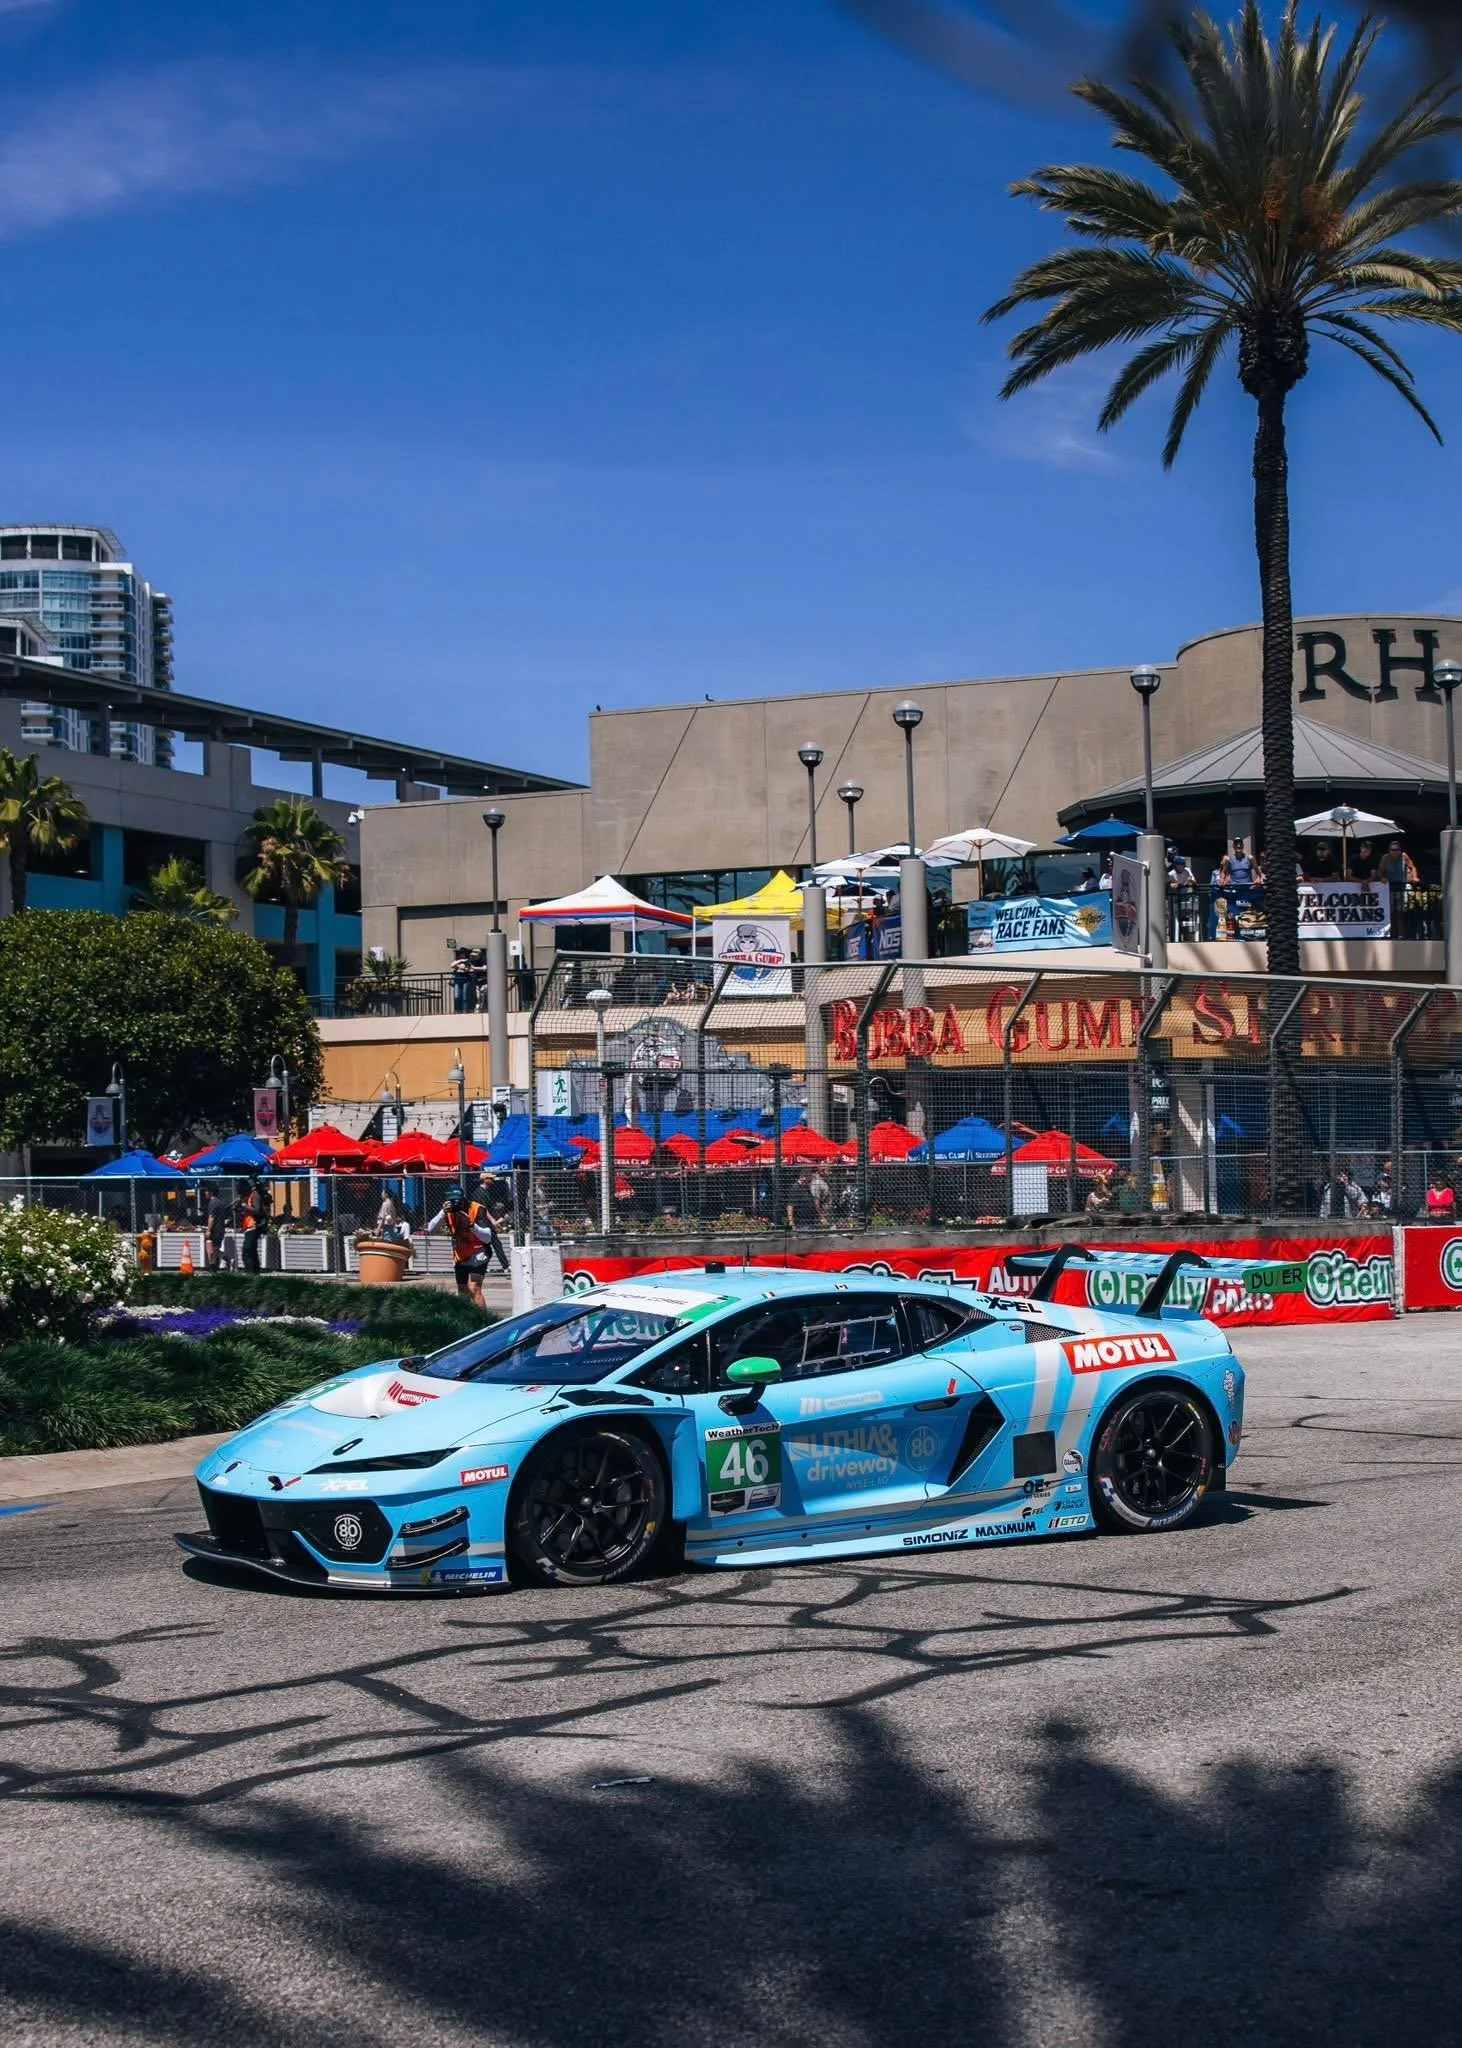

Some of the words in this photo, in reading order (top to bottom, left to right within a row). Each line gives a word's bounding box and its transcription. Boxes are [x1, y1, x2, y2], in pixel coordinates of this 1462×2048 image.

[1296, 628, 1443, 704] RH
[995, 906, 1042, 921] WELCOME
[1298, 908, 1337, 922] ACE
[1337, 908, 1385, 922] FANS
[995, 921, 1029, 939] RACE
[1032, 918, 1066, 937] FANS
[878, 927, 902, 950] NOS
[832, 999, 968, 1061] BUBBA
[986, 1265, 1042, 1293] AUT
[1308, 1256, 1394, 1299] O'Reill
[985, 1295, 1043, 1314] XPEL
[1073, 1337, 1170, 1369] MOTUL
[707, 1423, 779, 1439] WeatherTech
[912, 1436, 936, 1458] 80
[720, 1440, 769, 1486] 46
[463, 1467, 508, 1483] MOTUL
[322, 1478, 369, 1492] XPEL
[975, 1521, 1036, 1538] MAXIMUM
[1061, 1515, 1087, 1526] GTD
[339, 1523, 358, 1538] 80
[445, 1571, 496, 1580] MICHELIN
